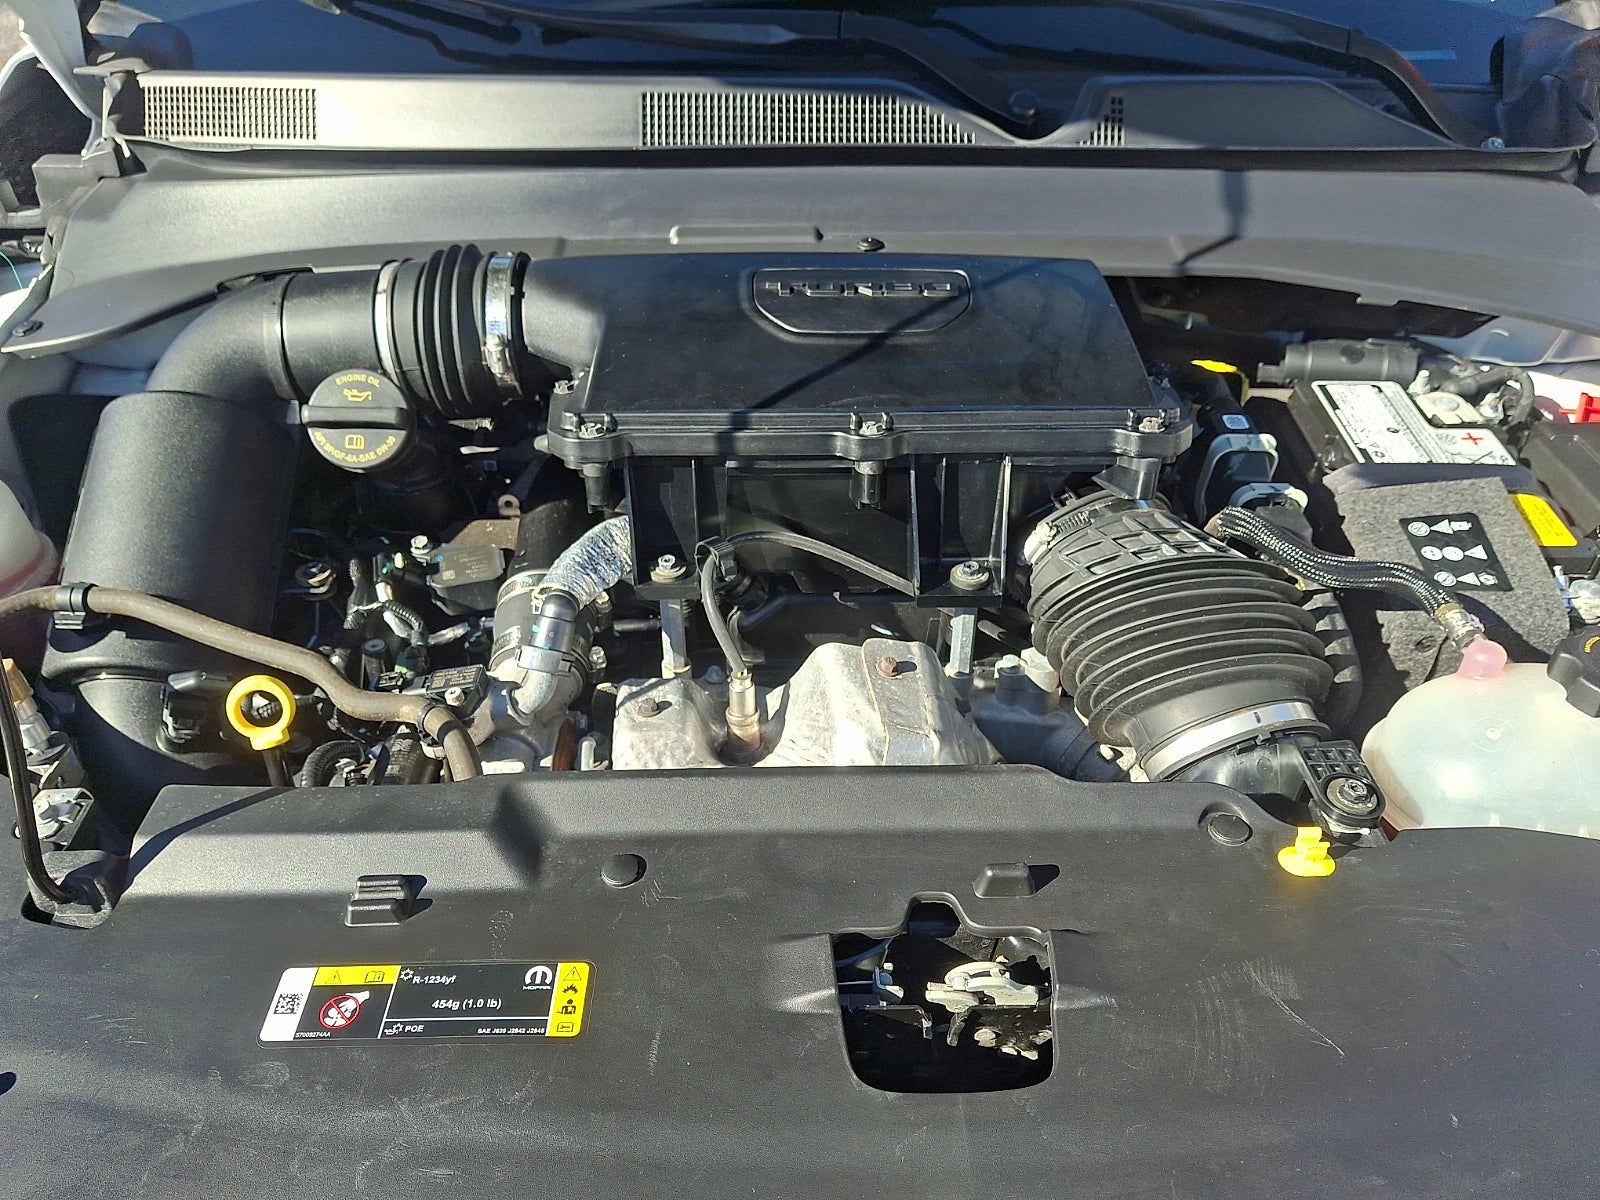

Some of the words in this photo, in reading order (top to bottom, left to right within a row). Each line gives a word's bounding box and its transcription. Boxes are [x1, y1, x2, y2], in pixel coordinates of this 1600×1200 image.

[335, 374, 367, 386] ENGINE
[367, 376, 381, 388] OIL
[412, 975, 457, 985] R-1234yf
[431, 999, 460, 1011] 454g
[462, 998, 484, 1010] (1.0
[486, 998, 502, 1010] lb)
[404, 1024, 424, 1033] POE
